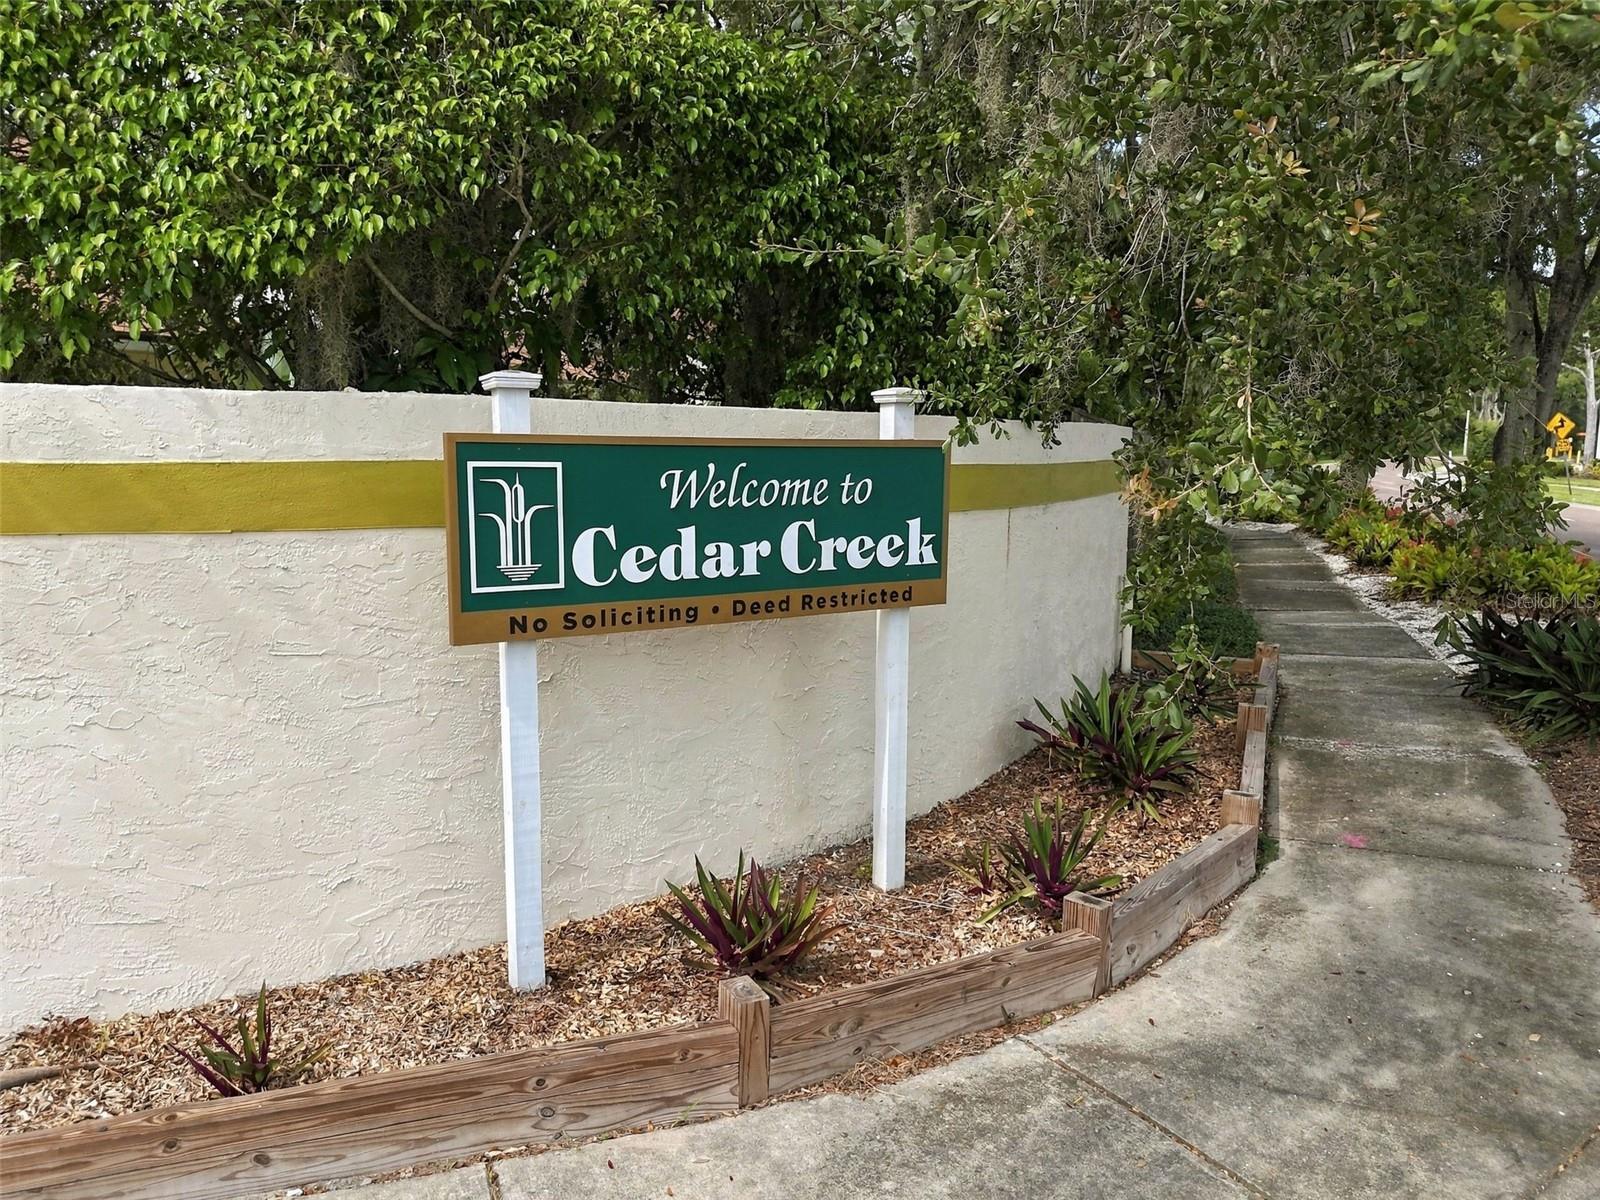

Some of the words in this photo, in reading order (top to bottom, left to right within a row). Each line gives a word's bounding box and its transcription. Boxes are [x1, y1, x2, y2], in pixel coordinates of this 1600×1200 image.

[660, 462, 829, 509] Welcome
[840, 472, 873, 505] to
[571, 524, 772, 587] Cedar
[780, 516, 938, 574] Creek
[509, 615, 549, 636] No
[562, 605, 699, 631] Soliciting
[732, 594, 791, 617] Deed
[800, 585, 914, 611] Restricted
